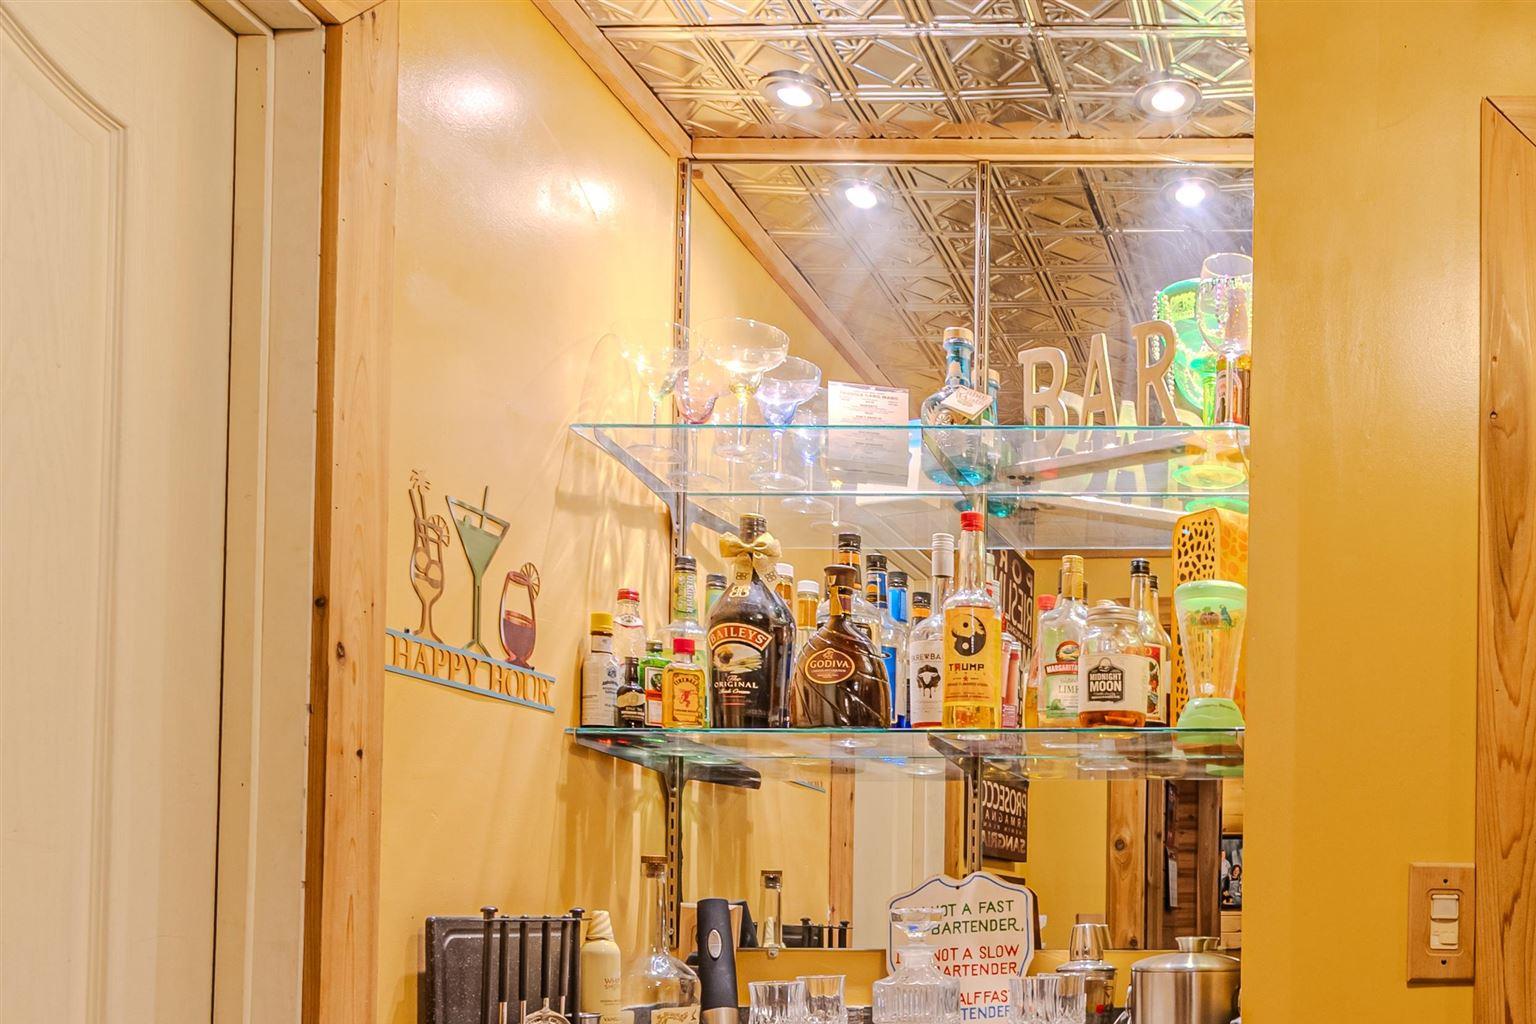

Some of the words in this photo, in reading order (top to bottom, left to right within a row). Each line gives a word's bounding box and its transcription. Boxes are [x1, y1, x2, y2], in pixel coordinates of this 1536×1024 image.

[1018, 319, 1181, 458] BAR
[709, 626, 768, 645] BAILEYS
[393, 634, 479, 687] HAPPY
[489, 660, 555, 708] HOUR
[809, 659, 850, 669] GODIVA
[948, 662, 985, 672] TRUMP
[713, 680, 759, 690] ORIGINAL
[1089, 672, 1122, 681] MIDNIGHT
[1089, 680, 1122, 694] MOON
[961, 902, 972, 916] A
[978, 899, 1015, 915] FAST
[962, 946, 974, 961] A
[979, 943, 1020, 960] SLOW
[936, 961, 1021, 978] ARTENDER,
